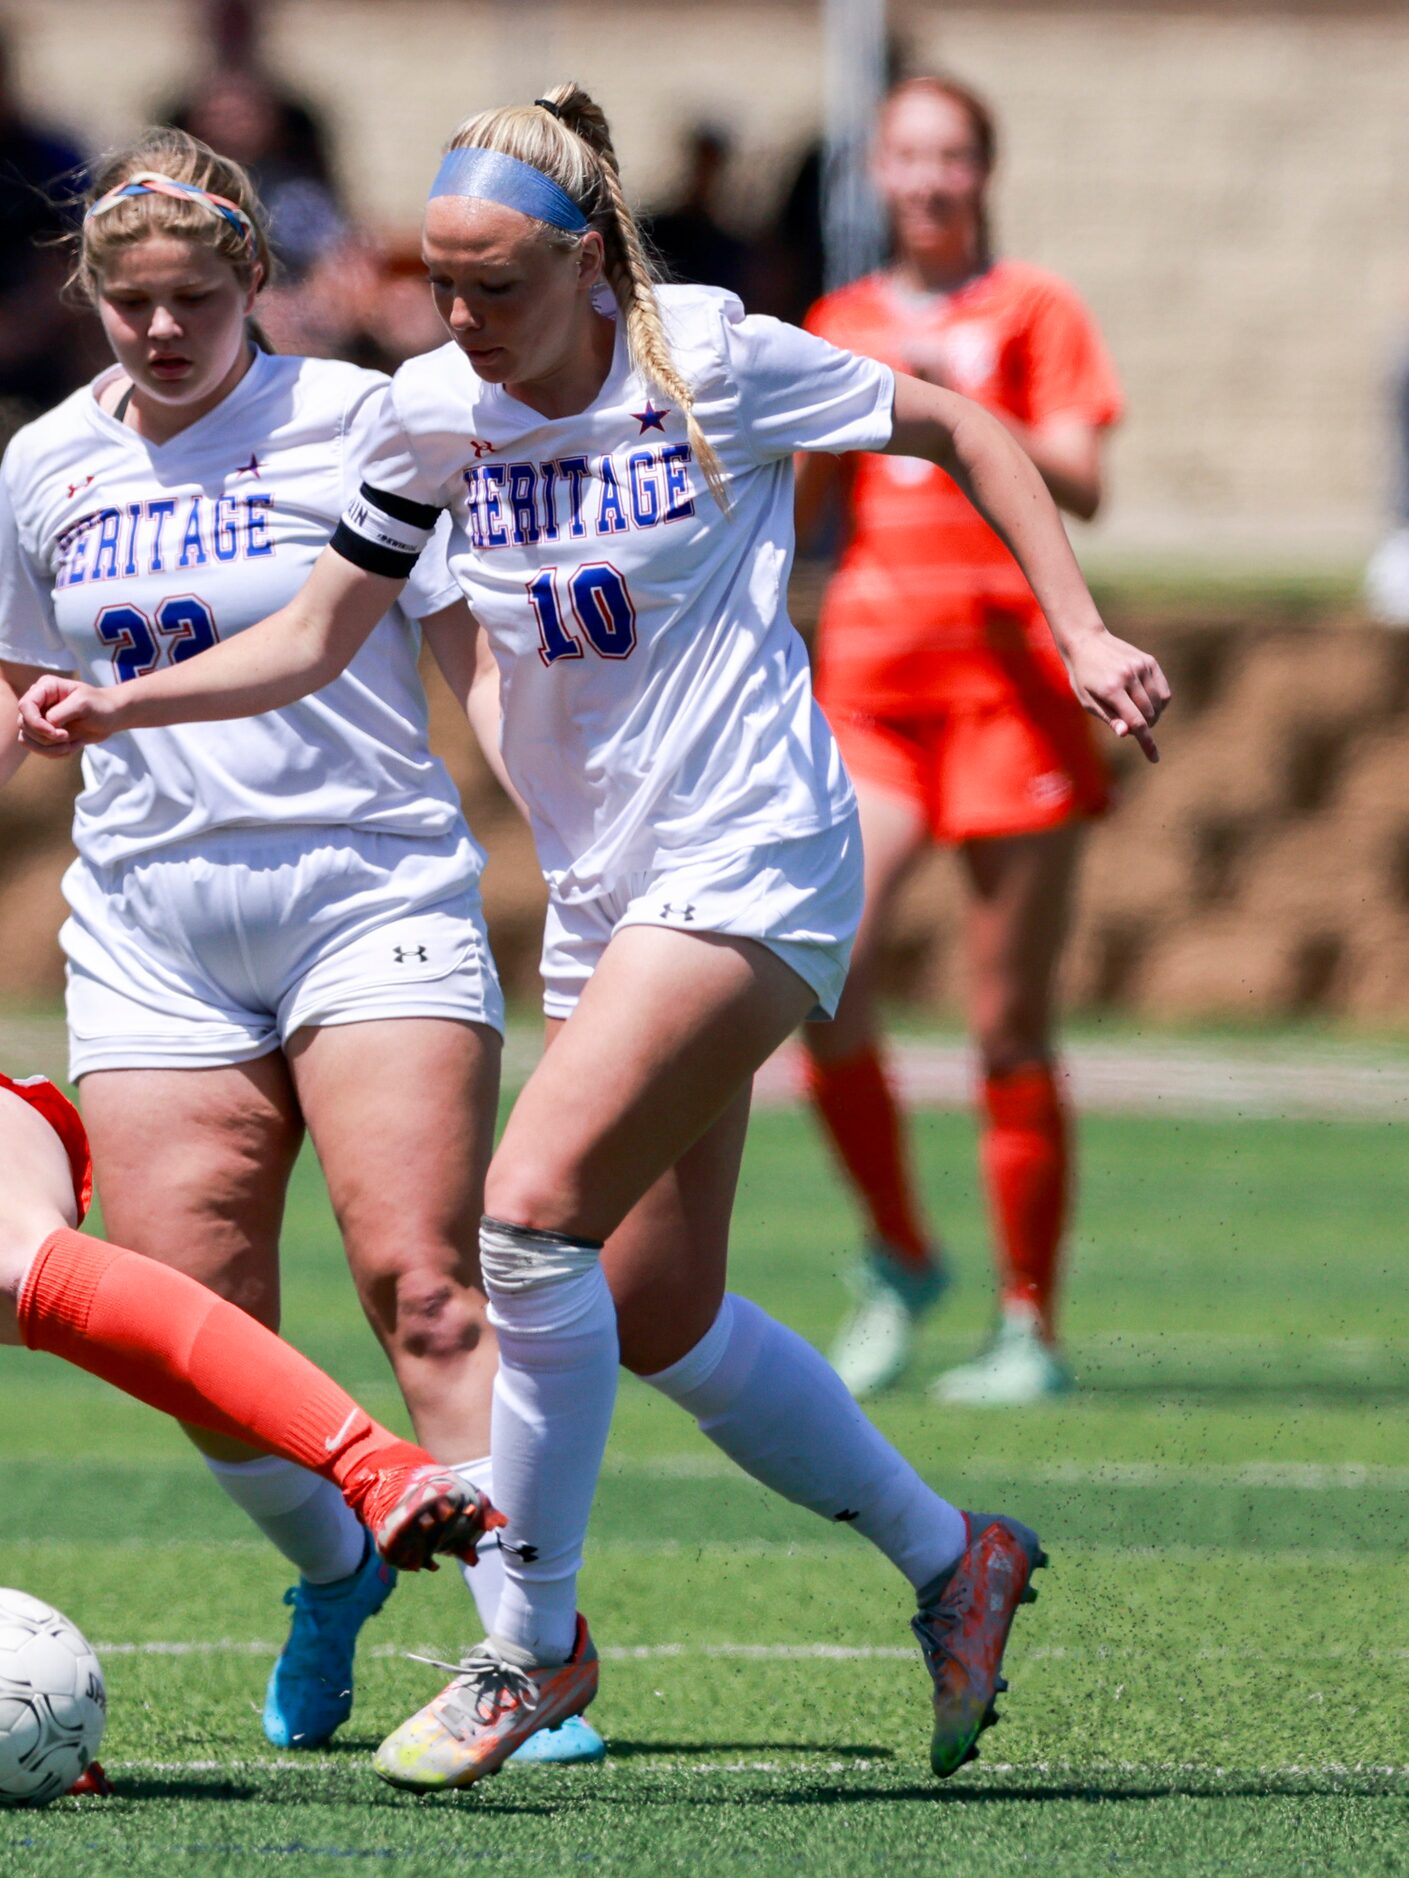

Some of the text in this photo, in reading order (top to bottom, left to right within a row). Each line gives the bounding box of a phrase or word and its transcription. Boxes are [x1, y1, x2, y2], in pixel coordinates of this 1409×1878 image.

[464, 442, 696, 550] HERITAGE
[94, 592, 220, 684] 22
[526, 561, 637, 667] 10
